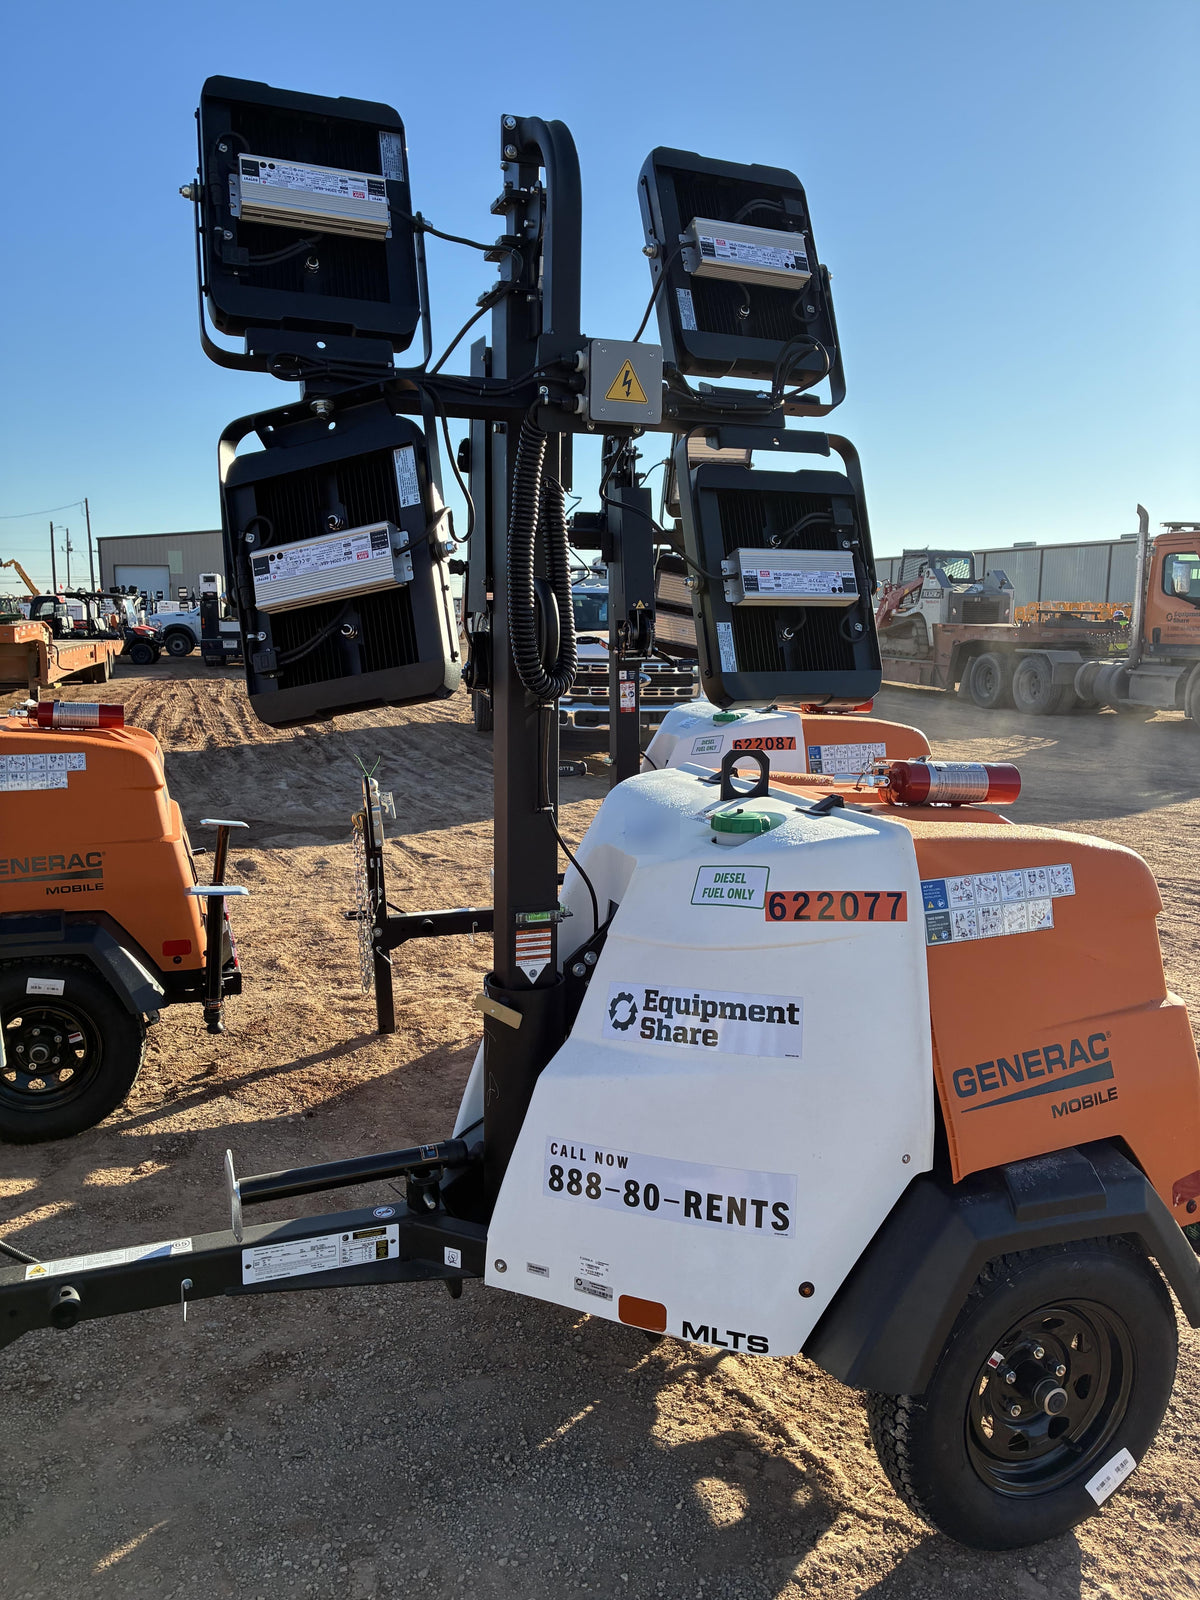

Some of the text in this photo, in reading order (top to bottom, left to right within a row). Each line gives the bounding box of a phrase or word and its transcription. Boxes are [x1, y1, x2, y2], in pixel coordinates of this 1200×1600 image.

[734, 737, 794, 751] 622087
[46, 883, 104, 895] MOBILE
[702, 887, 755, 901] FUEL ONLY
[713, 873, 747, 885] DIESEL
[769, 892, 903, 921] 622077
[642, 988, 800, 1025] Equipment
[639, 1016, 719, 1047] Share
[952, 1032, 1111, 1098] GENERAC
[1051, 1086, 1119, 1119] MOBILE
[550, 1142, 629, 1169] CALL NOW
[548, 1164, 790, 1231] 888-80-RENTS
[682, 1320, 770, 1354] MLTS
